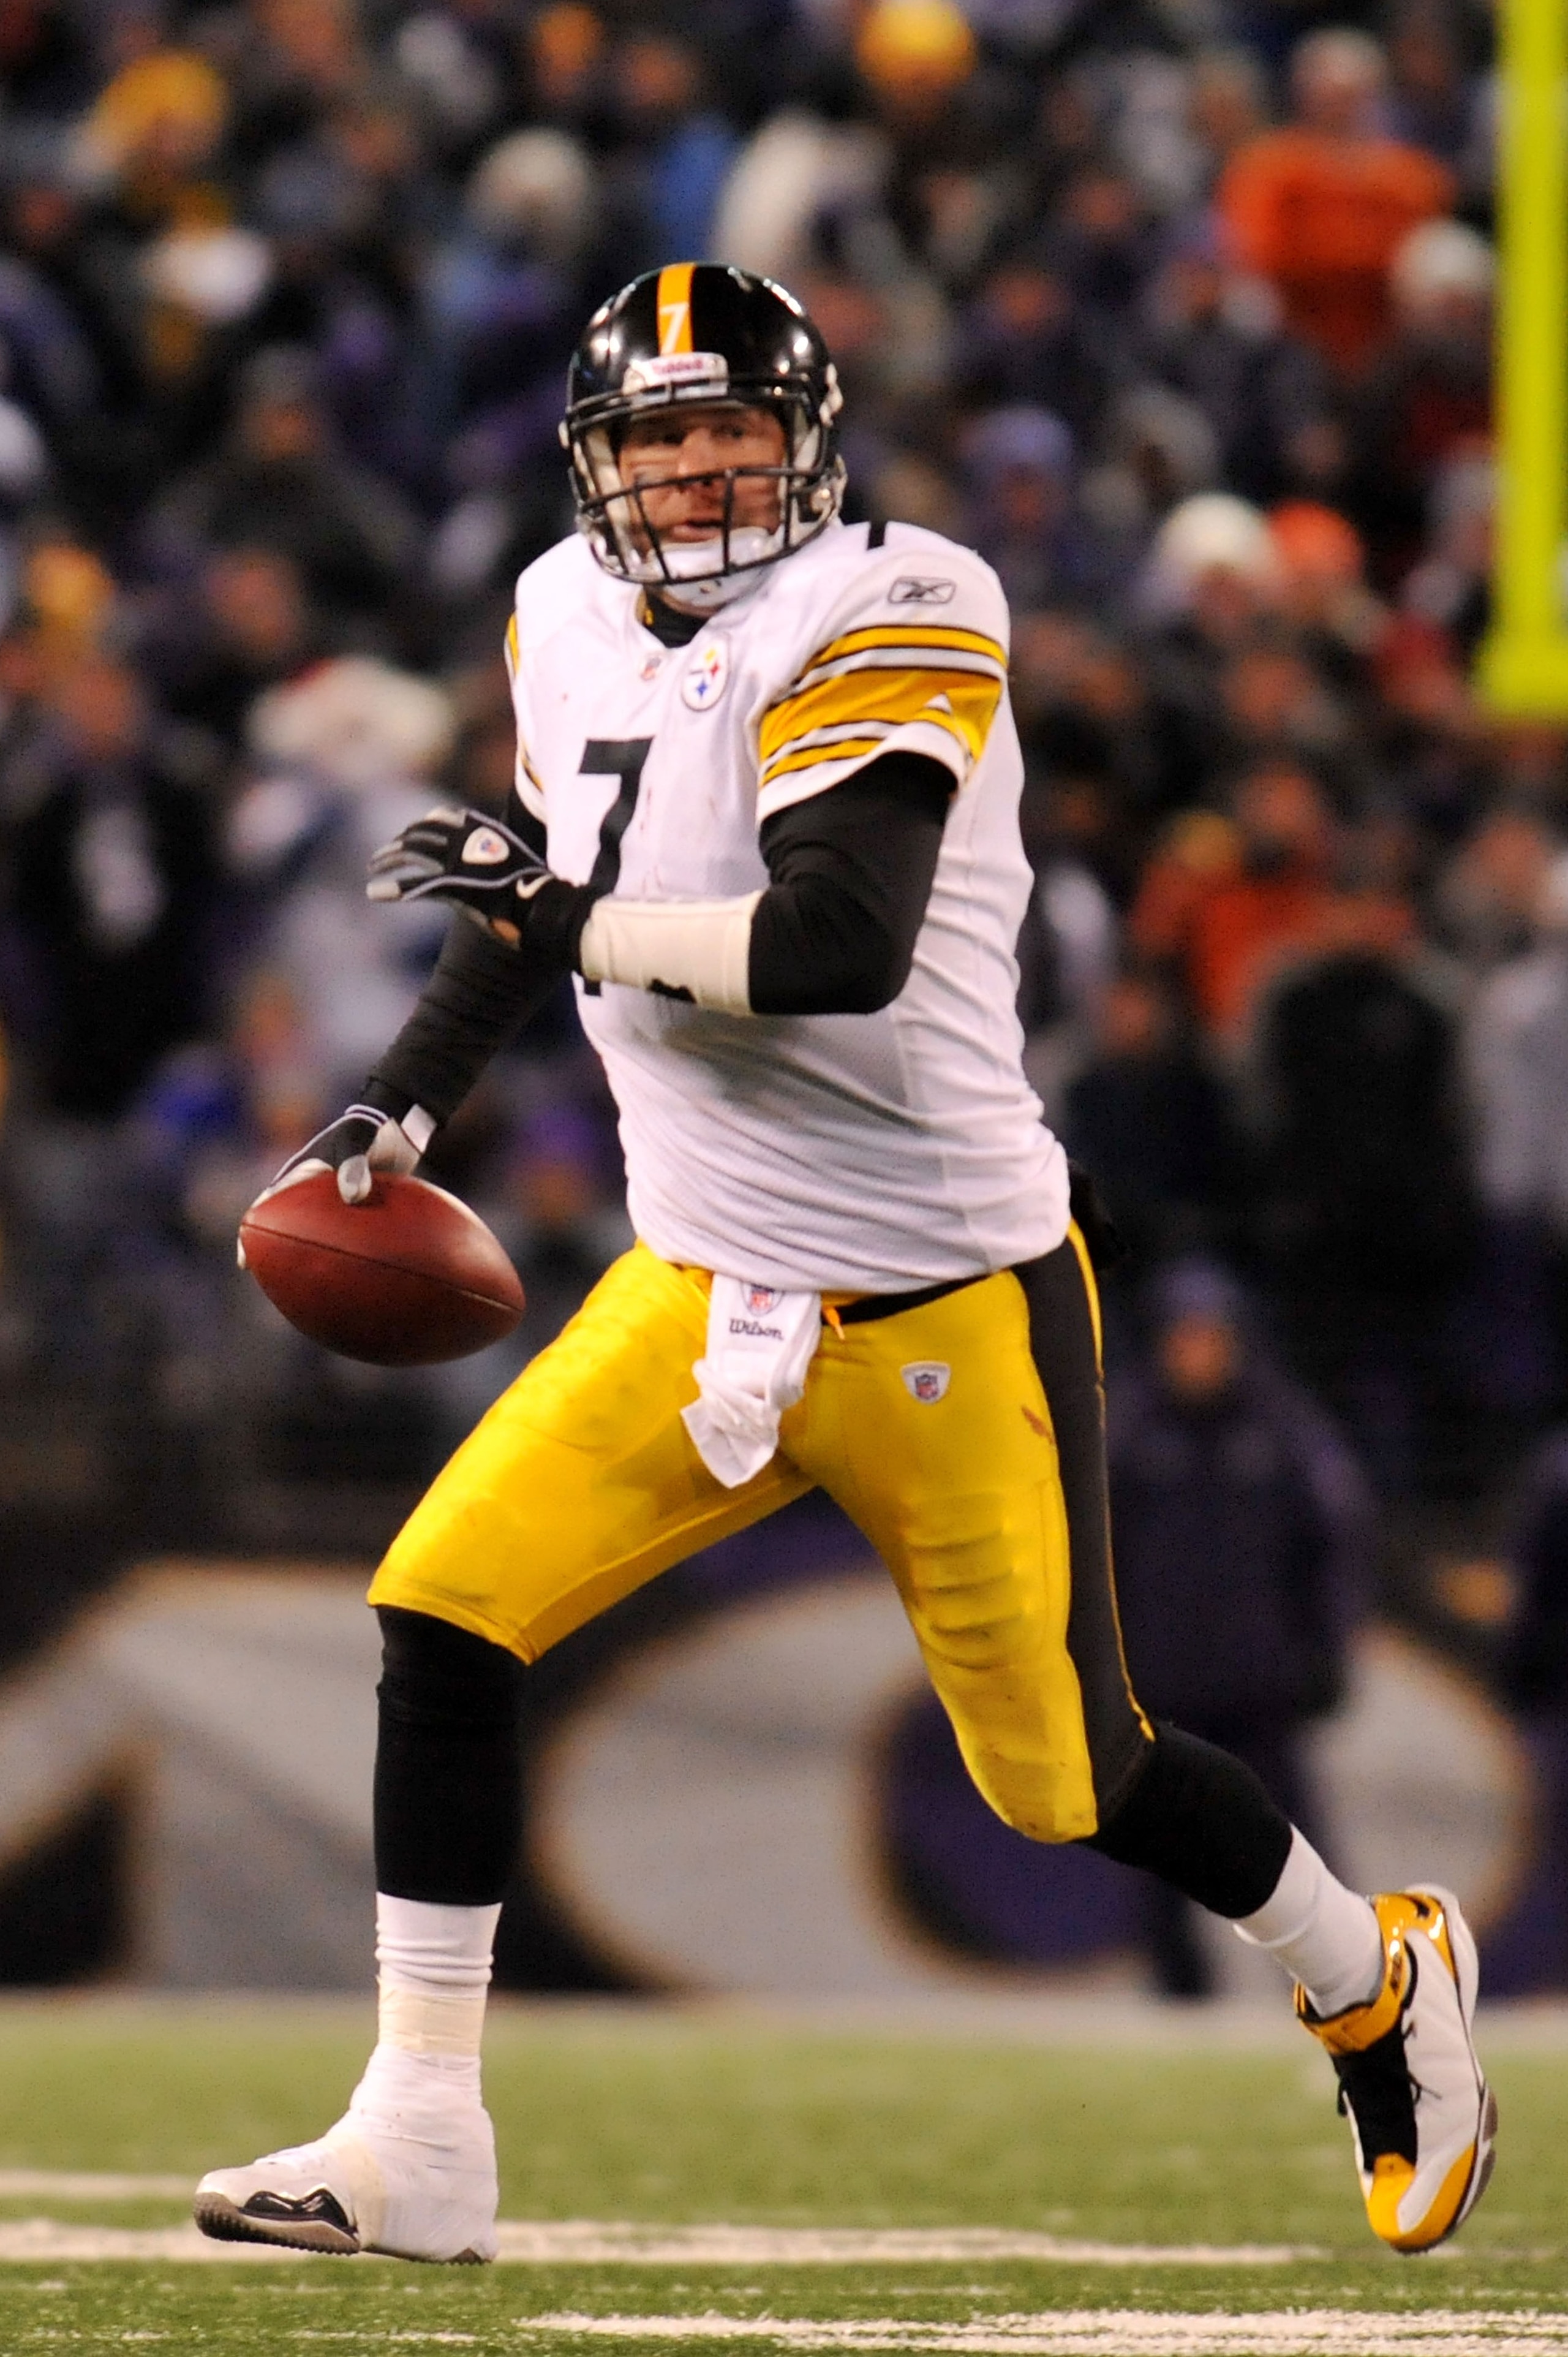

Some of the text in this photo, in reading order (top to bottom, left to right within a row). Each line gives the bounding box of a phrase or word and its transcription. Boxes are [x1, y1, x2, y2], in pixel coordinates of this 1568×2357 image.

[659, 301, 690, 356] 7
[578, 735, 655, 996] 7
[729, 1318, 783, 1341] Wilson
